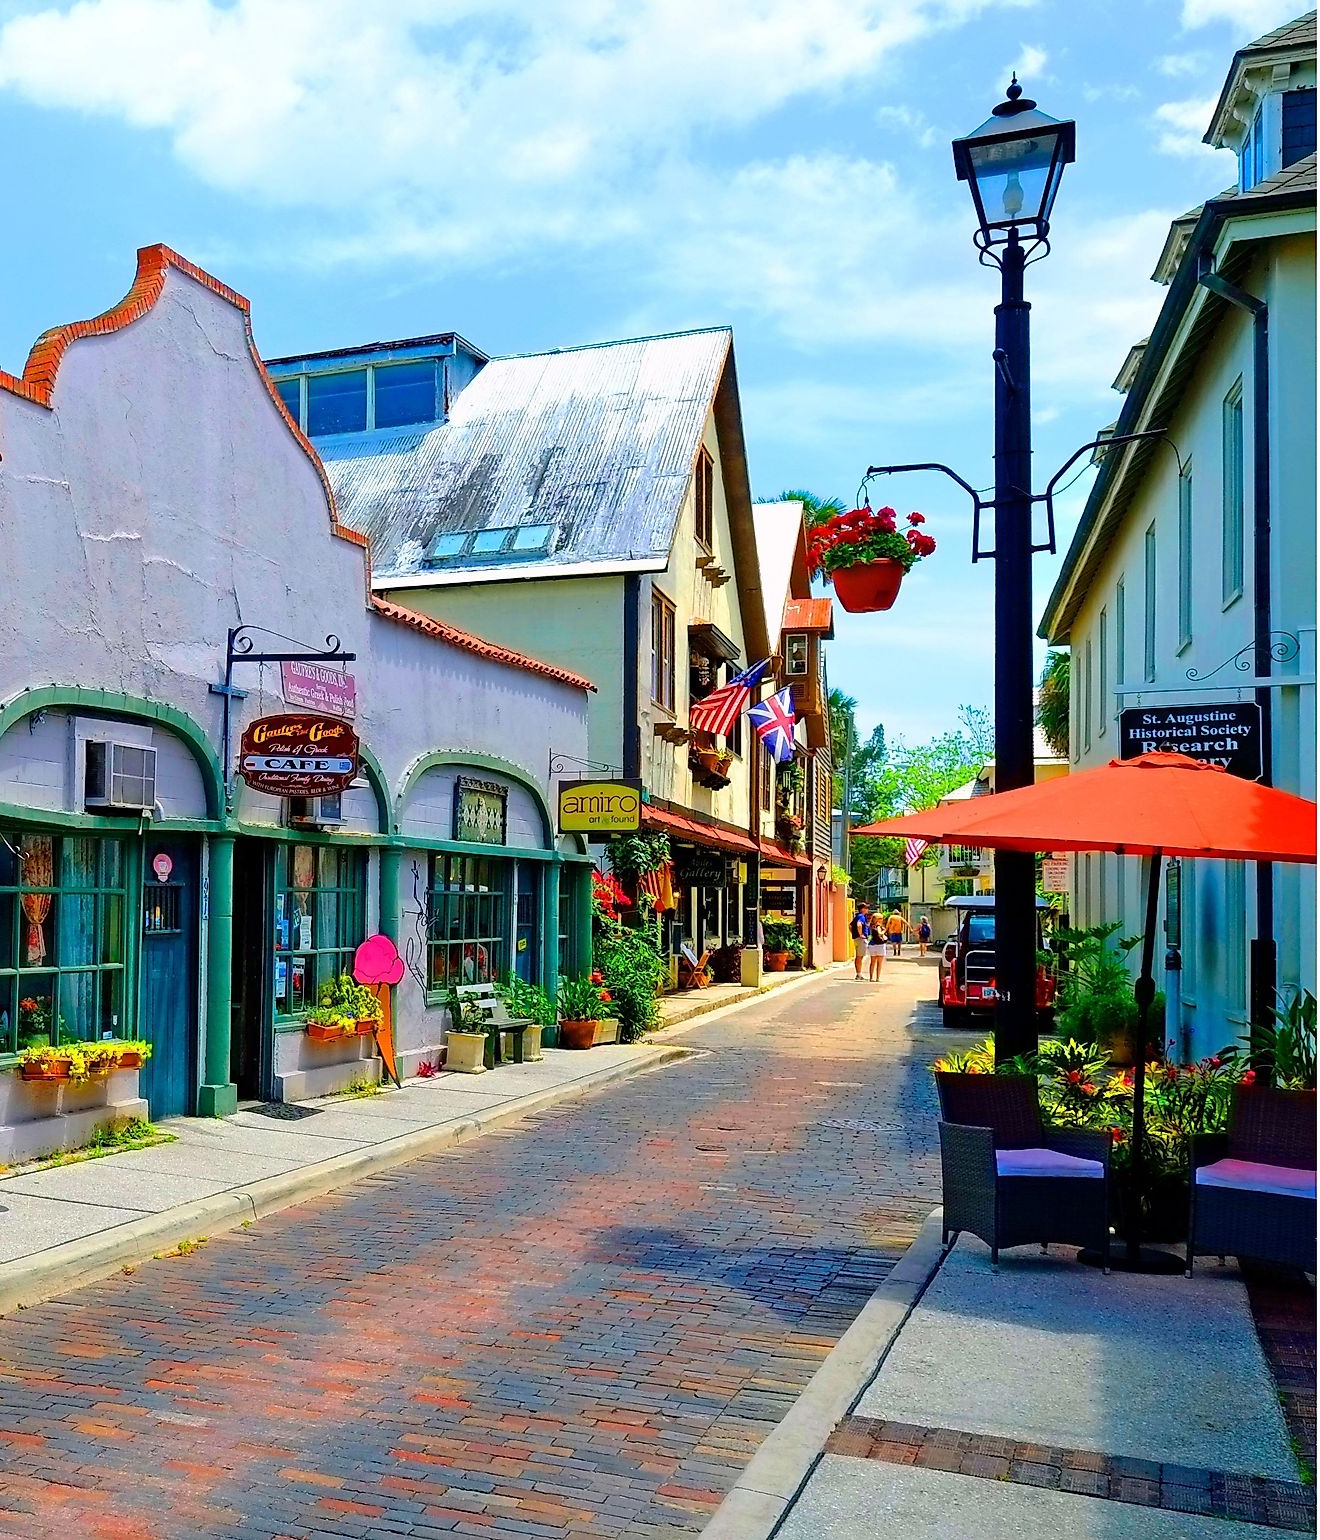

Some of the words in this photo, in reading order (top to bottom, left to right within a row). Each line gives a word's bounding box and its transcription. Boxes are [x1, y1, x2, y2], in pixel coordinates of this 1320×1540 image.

[310, 688, 324, 700] Greek
[1142, 713, 1161, 724] St.
[1165, 711, 1236, 725] Augustine
[309, 722, 343, 742] Goods
[1129, 726, 1197, 739] Historical
[1200, 724, 1251, 736] Society
[268, 743, 290, 753] Polish
[304, 744, 328, 755] Greek
[264, 758, 330, 770] CAFE
[562, 791, 637, 813] amiro
[589, 815, 601, 823] art
[610, 815, 635, 823] found
[679, 866, 722, 880] Gallery
